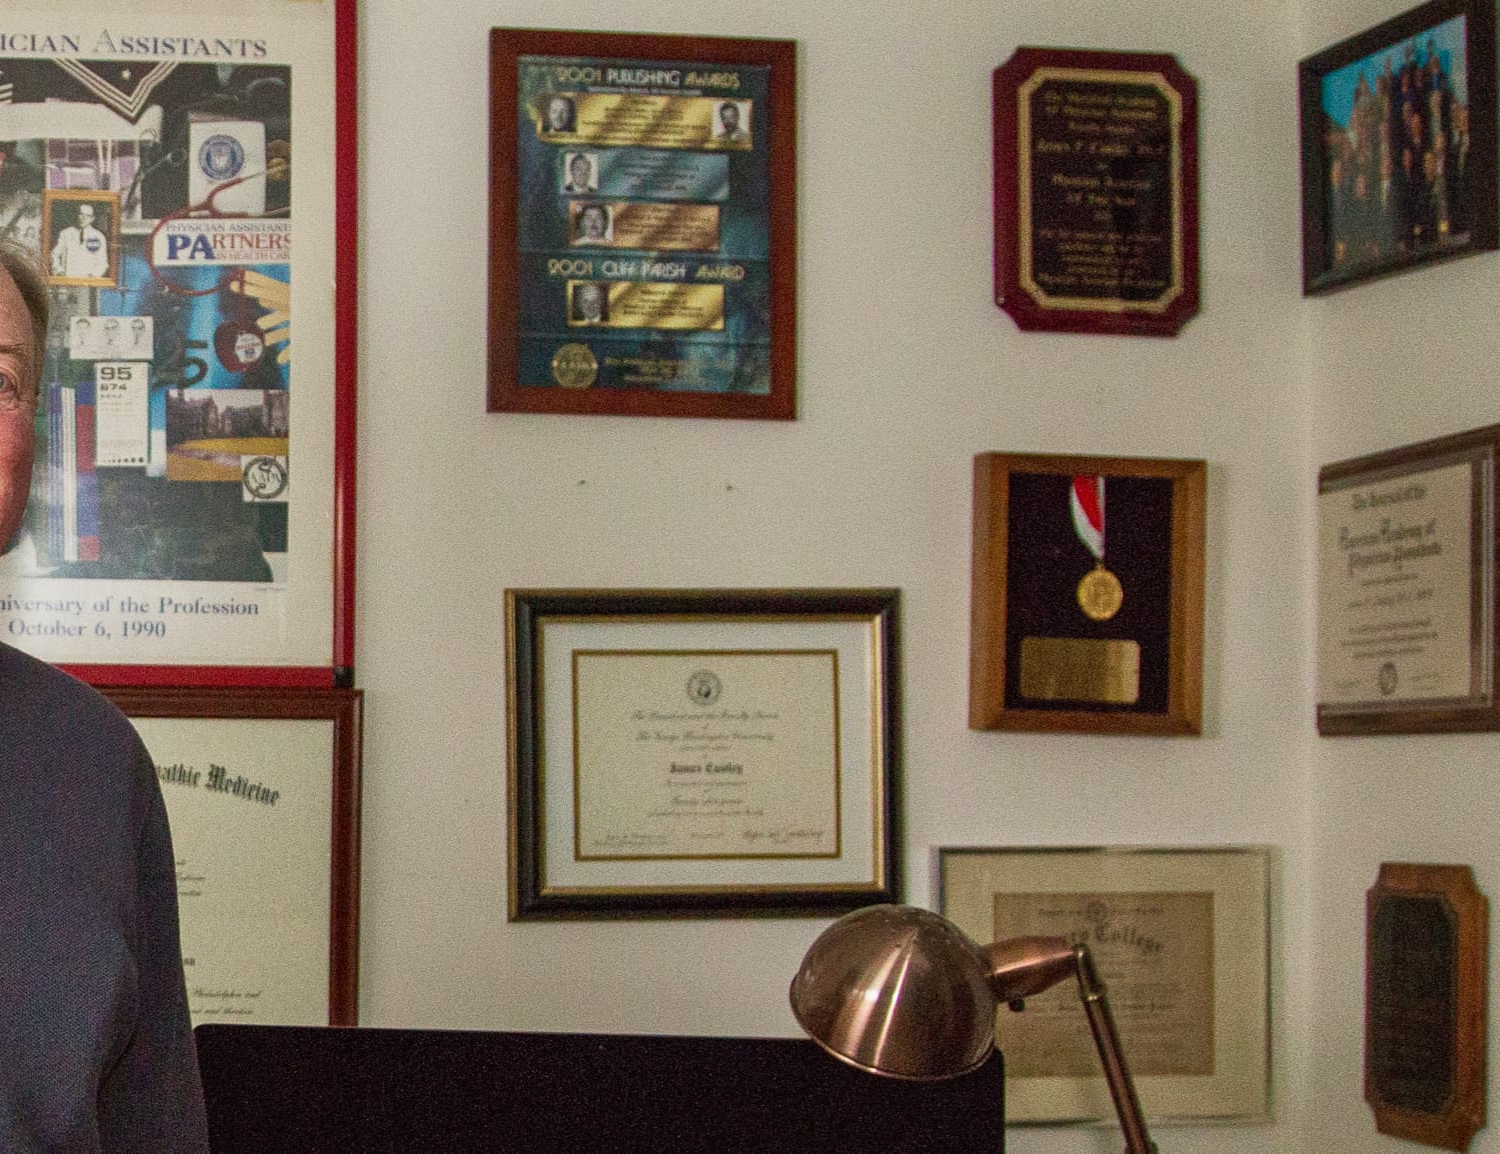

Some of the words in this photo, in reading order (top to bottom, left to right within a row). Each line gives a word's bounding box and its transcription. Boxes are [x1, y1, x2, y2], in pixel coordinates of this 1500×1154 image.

[93, 31, 270, 57] ASSISTANTS
[167, 222, 226, 232] PHYSICIAN
[100, 366, 133, 381] 95
[93, 596, 112, 614] of
[119, 596, 150, 614] the
[159, 596, 259, 616] Profession
[8, 617, 86, 636] October
[94, 618, 111, 638] 6,
[121, 617, 166, 637] 1990
[205, 763, 280, 807] Medicine
